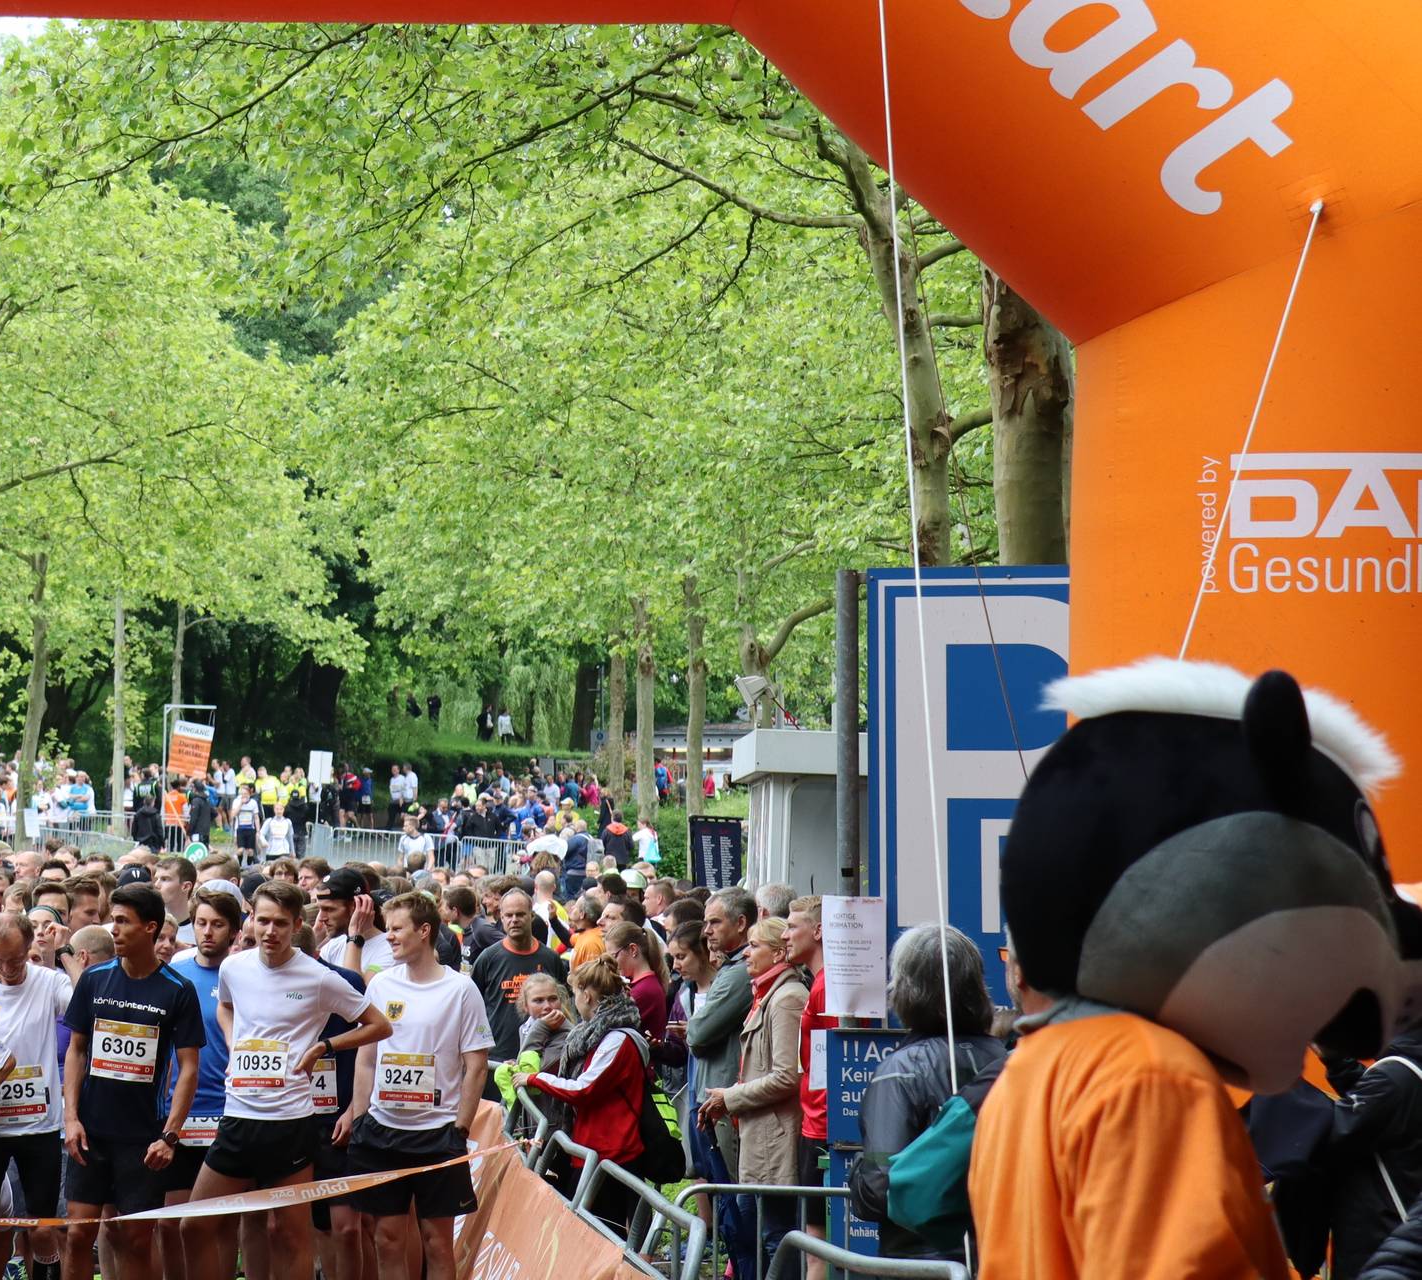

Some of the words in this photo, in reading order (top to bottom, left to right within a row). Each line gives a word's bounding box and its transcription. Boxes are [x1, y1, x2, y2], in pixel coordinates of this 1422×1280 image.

[958, 0, 1294, 215] art
[1197, 456, 1222, 484] by
[1229, 452, 1422, 539] DA
[1197, 492, 1221, 594] powered
[1228, 543, 1422, 594] Gesund
[286, 991, 303, 1000] wilo
[93, 996, 167, 1016] körlinginteriors
[102, 1037, 146, 1057] 6305
[237, 1055, 282, 1071] 10935
[385, 1069, 424, 1085] 9247
[842, 1107, 859, 1117] Das
